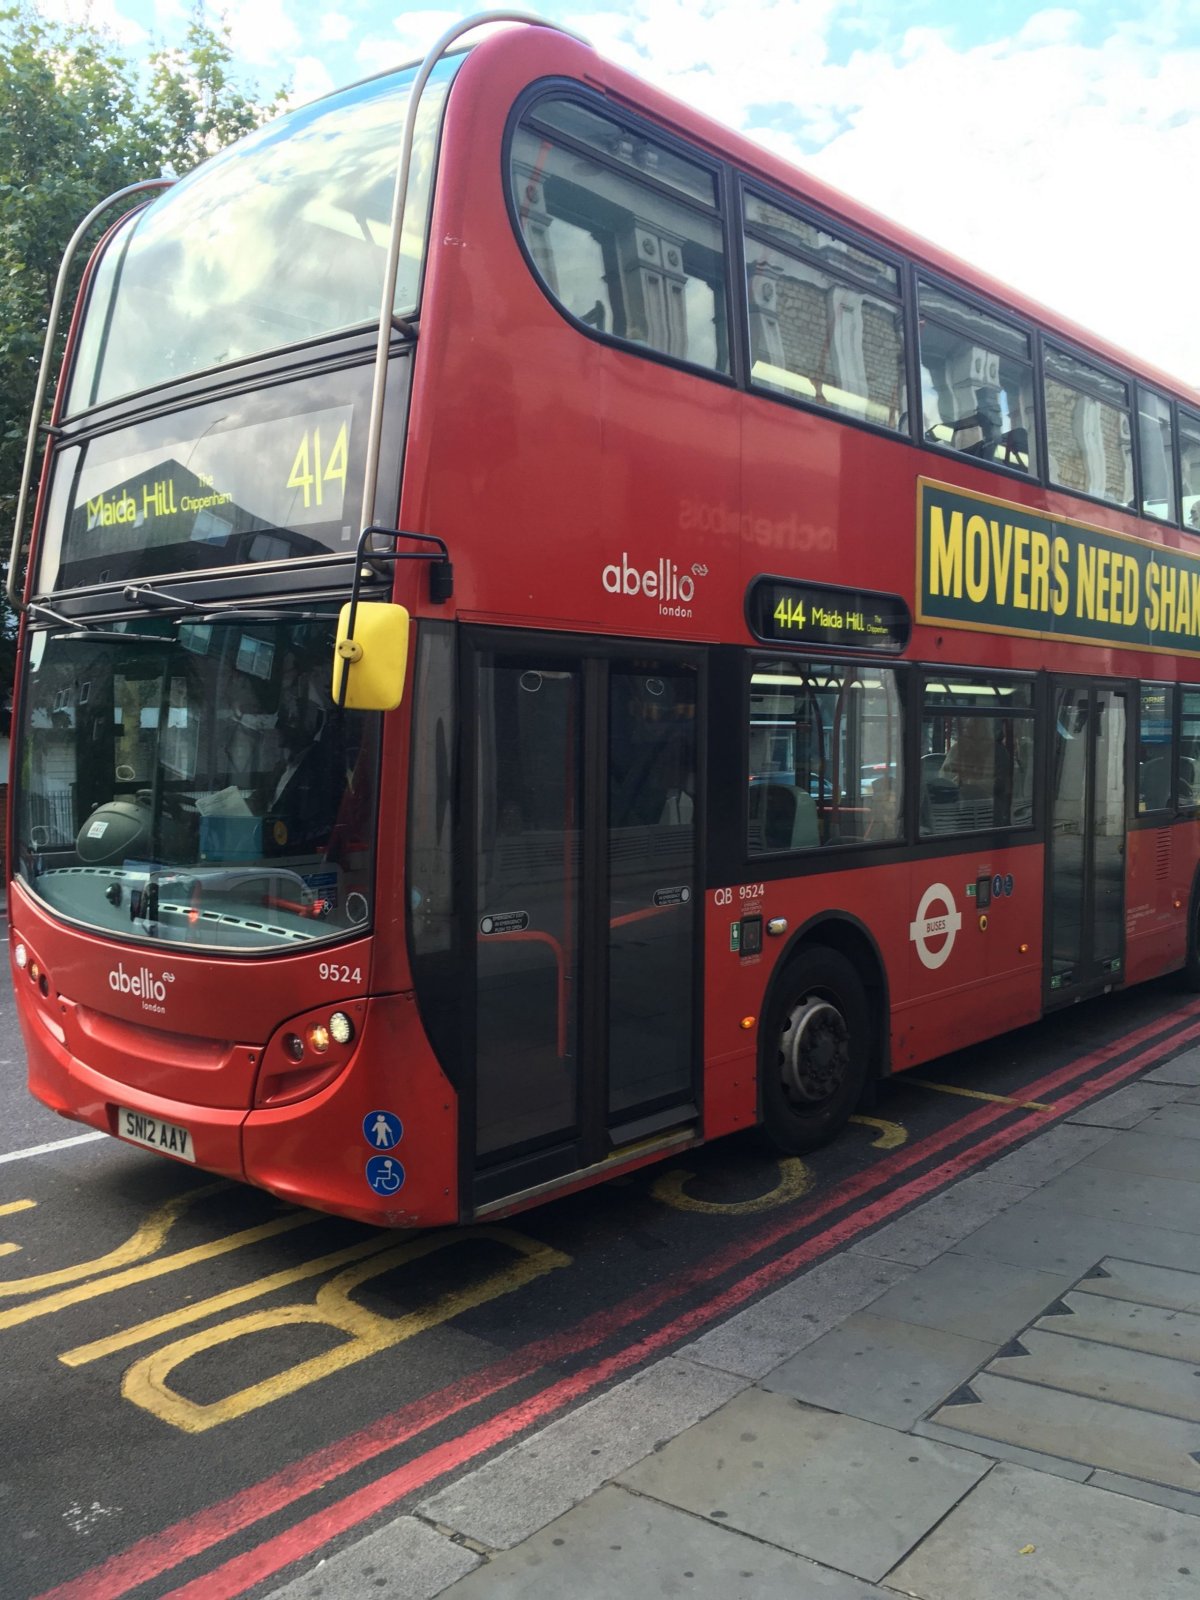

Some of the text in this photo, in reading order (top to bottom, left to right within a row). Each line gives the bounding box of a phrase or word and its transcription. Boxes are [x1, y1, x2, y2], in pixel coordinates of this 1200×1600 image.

[286, 419, 348, 508] 414
[86, 479, 177, 531] Maida Hill
[181, 490, 232, 514] Chippenham
[602, 552, 695, 602] abellio
[929, 505, 1070, 617] MOVERS
[1076, 543, 1140, 627] NEED
[659, 603, 693, 618] london
[774, 597, 865, 632] 414 Maida Hill
[714, 883, 765, 906] QB 9524
[926, 919, 946, 933] BUSES
[109, 962, 166, 1001] abellio
[318, 963, 362, 984] 9524
[142, 1000, 166, 1014] london
[126, 1112, 187, 1154] SN12 AAV
